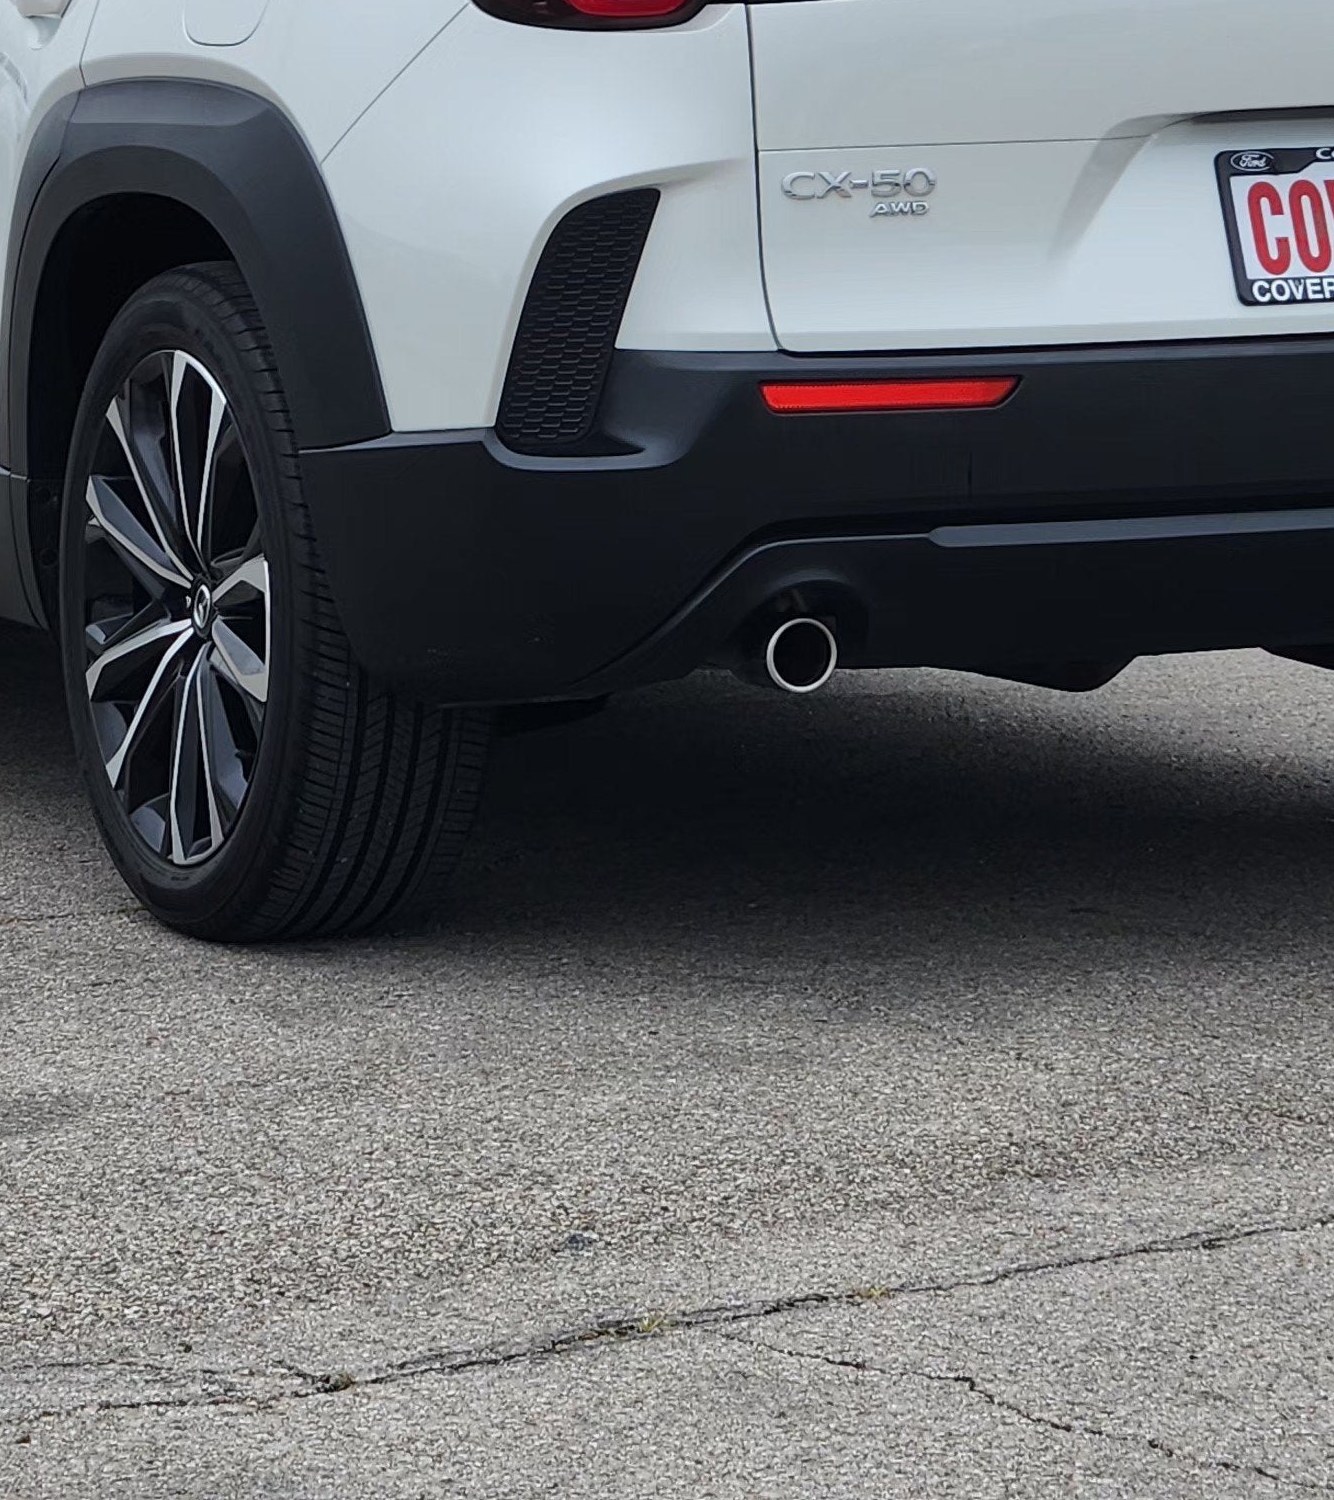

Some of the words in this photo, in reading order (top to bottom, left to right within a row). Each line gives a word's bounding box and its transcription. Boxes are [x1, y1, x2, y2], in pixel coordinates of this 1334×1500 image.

[1239, 154, 1267, 168] Ford
[781, 168, 935, 200] CX-50
[870, 201, 930, 217] AWD
